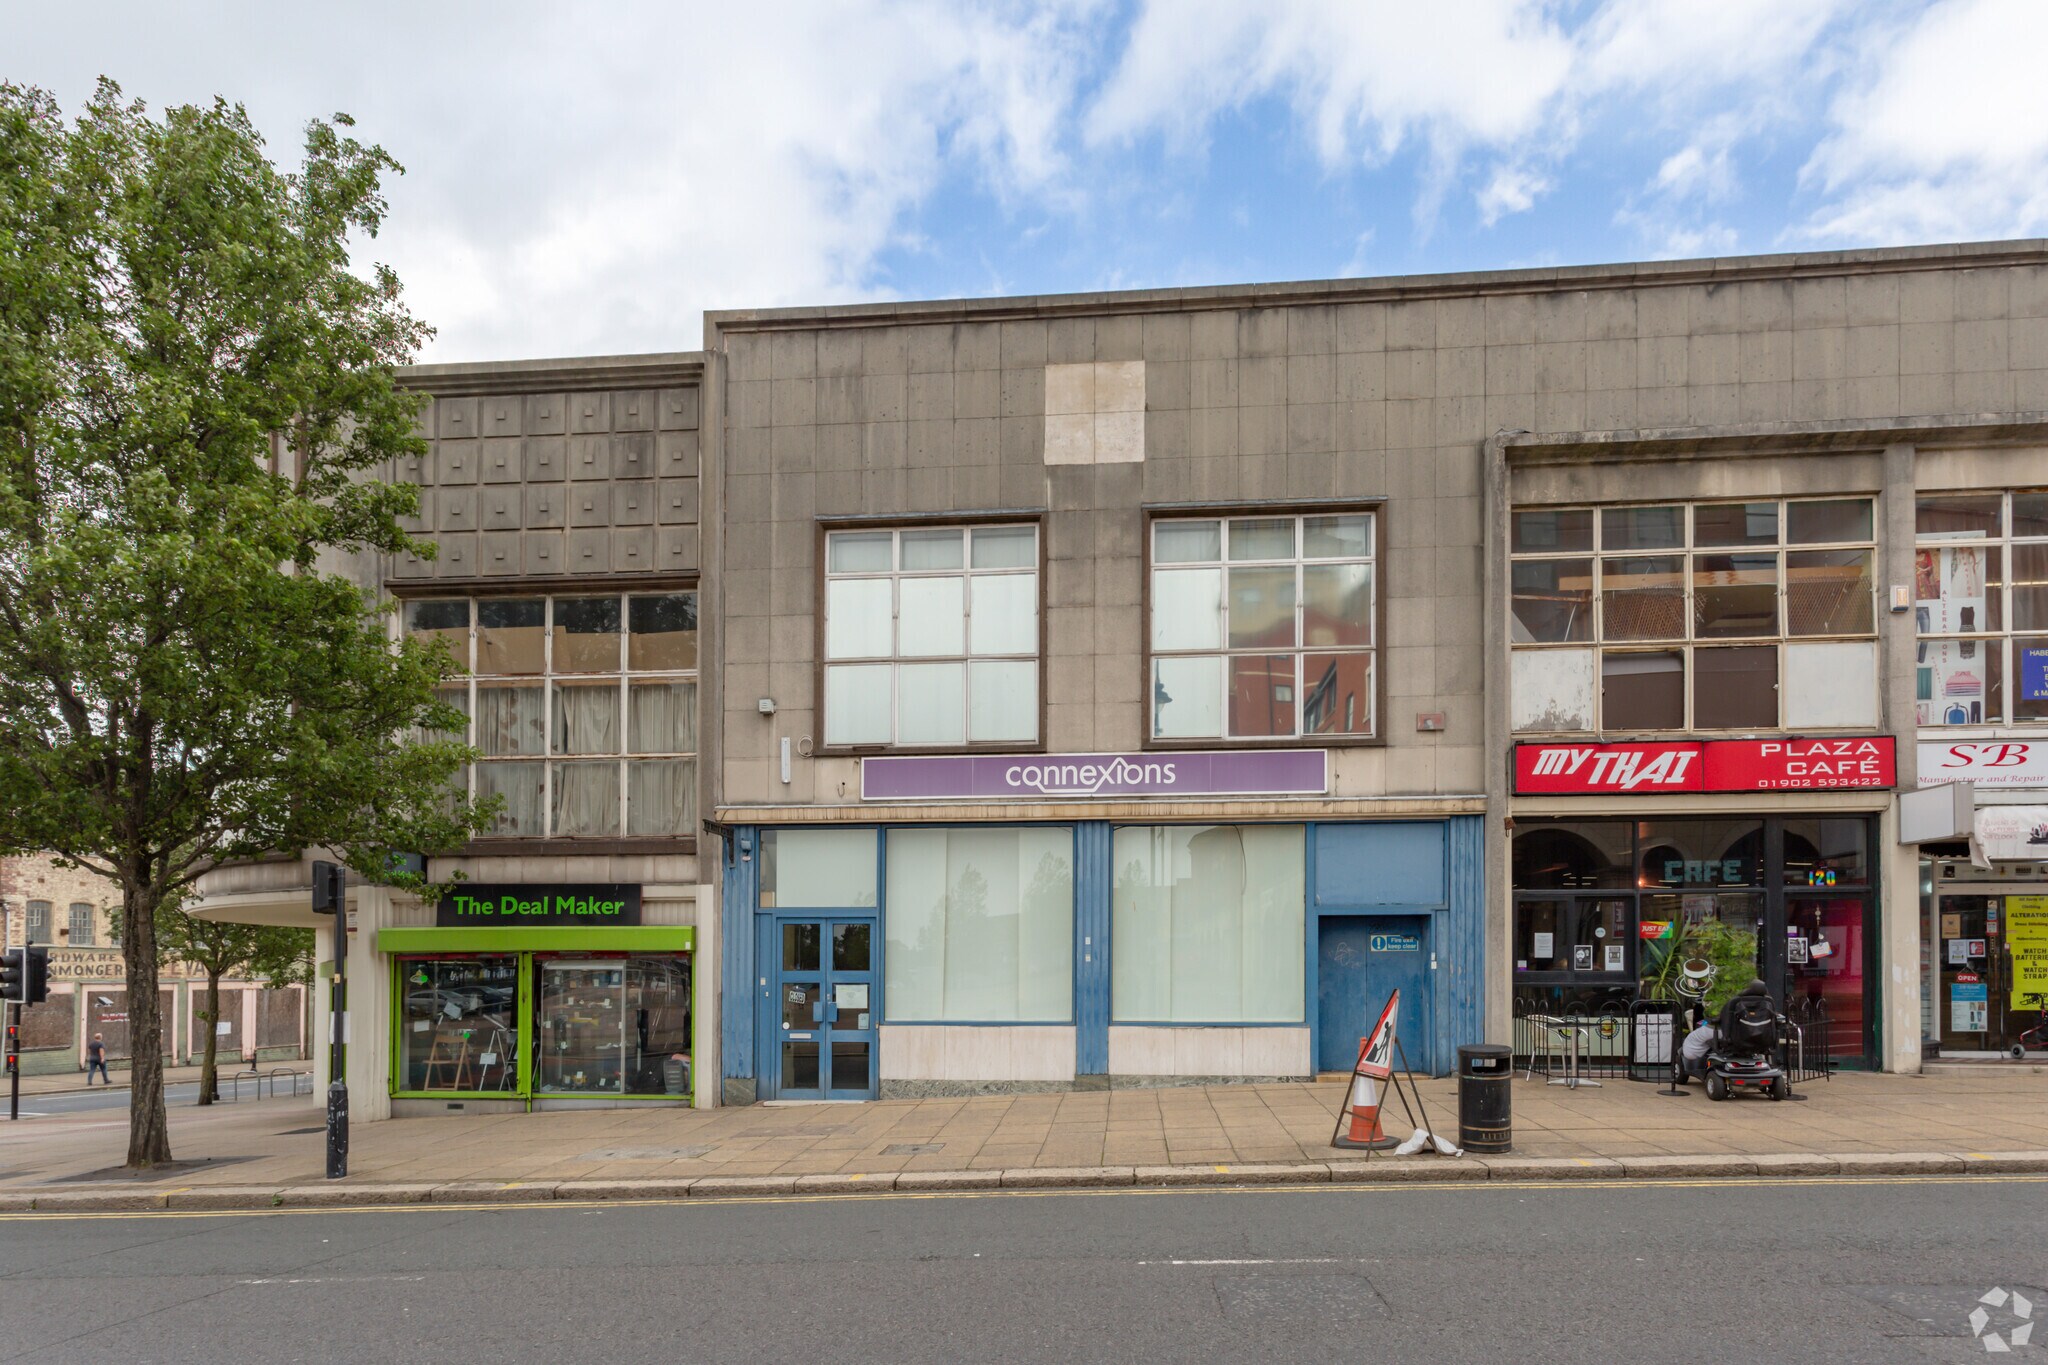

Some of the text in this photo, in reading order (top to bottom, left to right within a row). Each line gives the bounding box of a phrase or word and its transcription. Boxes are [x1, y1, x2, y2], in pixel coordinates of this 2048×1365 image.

[1761, 741, 1880, 757] PLAZA
[1941, 744, 2030, 767] SB
[1005, 757, 1176, 793] connexions
[1531, 748, 1698, 789] MY THAI
[1787, 756, 1880, 775] CAFÉ
[1918, 774, 2045, 784] Manufacture and Repair
[1664, 860, 1742, 883] CAFE
[1808, 871, 1836, 887] 120
[453, 896, 625, 915] The Deal Maker
[49, 952, 117, 963] RDWARE
[789, 992, 805, 1003] CLOSED
